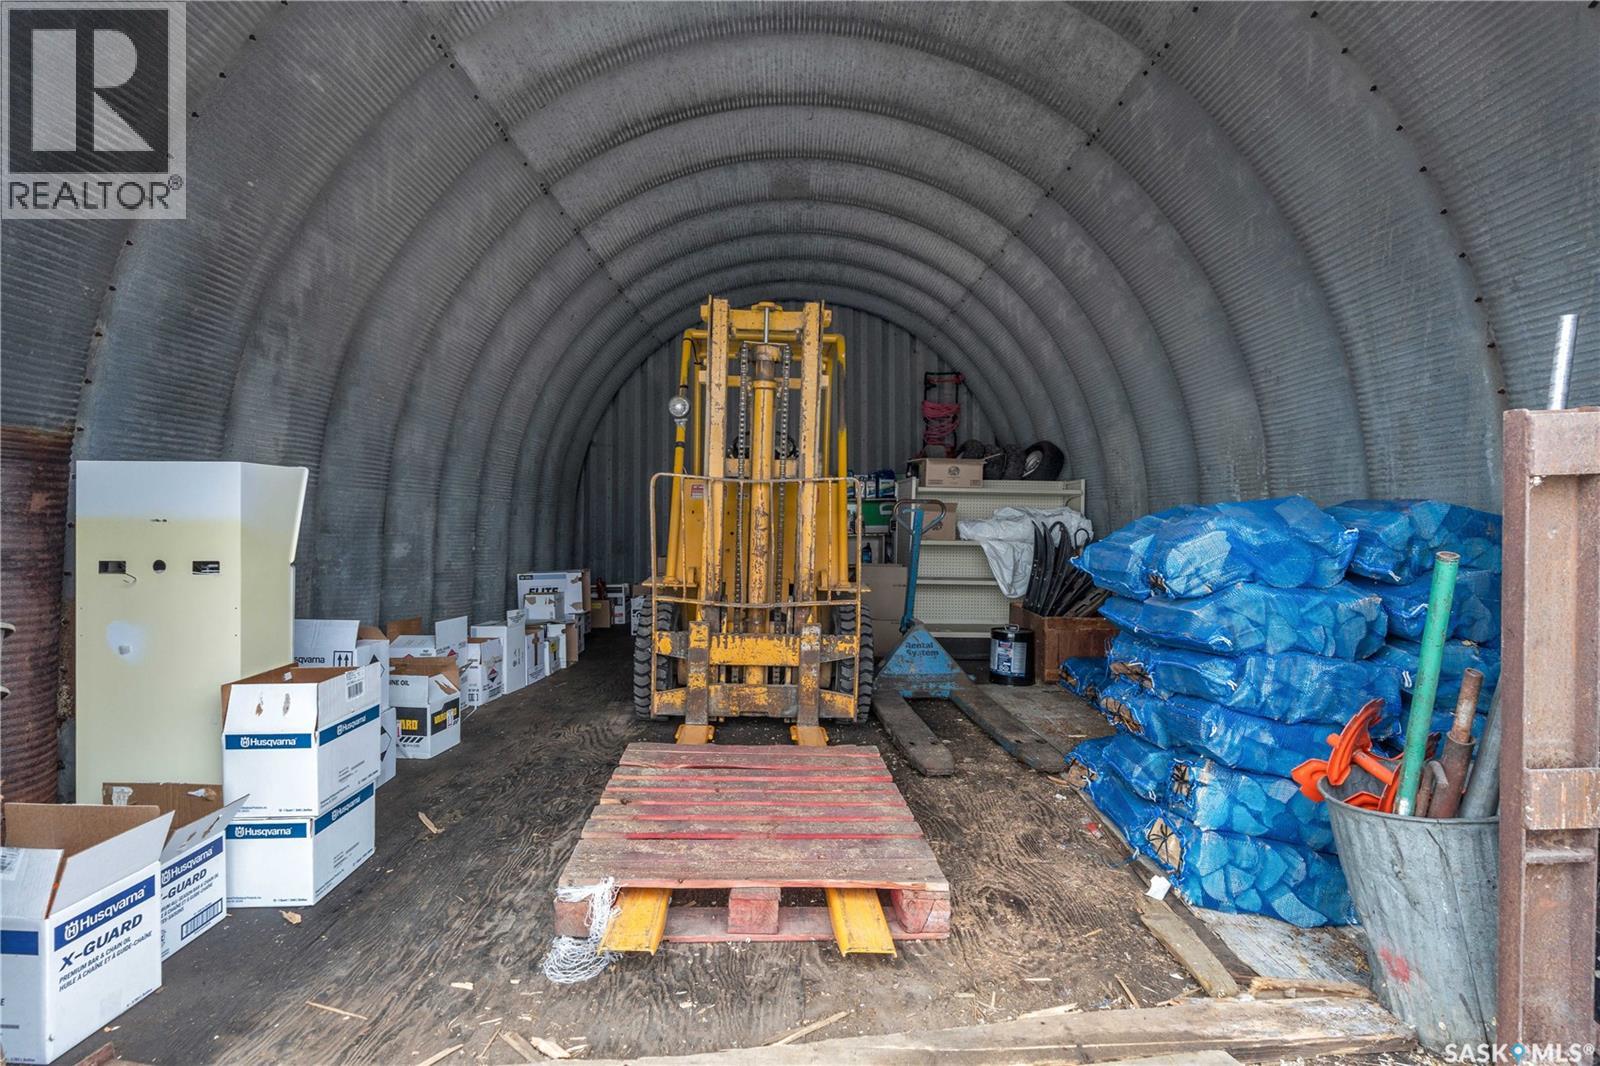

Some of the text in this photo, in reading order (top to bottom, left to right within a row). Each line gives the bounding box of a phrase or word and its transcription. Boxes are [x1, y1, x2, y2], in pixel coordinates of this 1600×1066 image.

[250, 738, 297, 747] Husqvarna
[245, 827, 292, 837] Husqvarna
[171, 847, 214, 876] Husqvarna
[161, 868, 207, 900] -GUARD
[79, 885, 147, 932] Husqvarna
[59, 914, 143, 972] X-GUARD
[58, 962, 87, 984] PREMIUM
[88, 955, 100, 967] BAR
[105, 942, 123, 955] CHAIN
[59, 976, 77, 992] HUILE
[104, 955, 111, 965] ET
